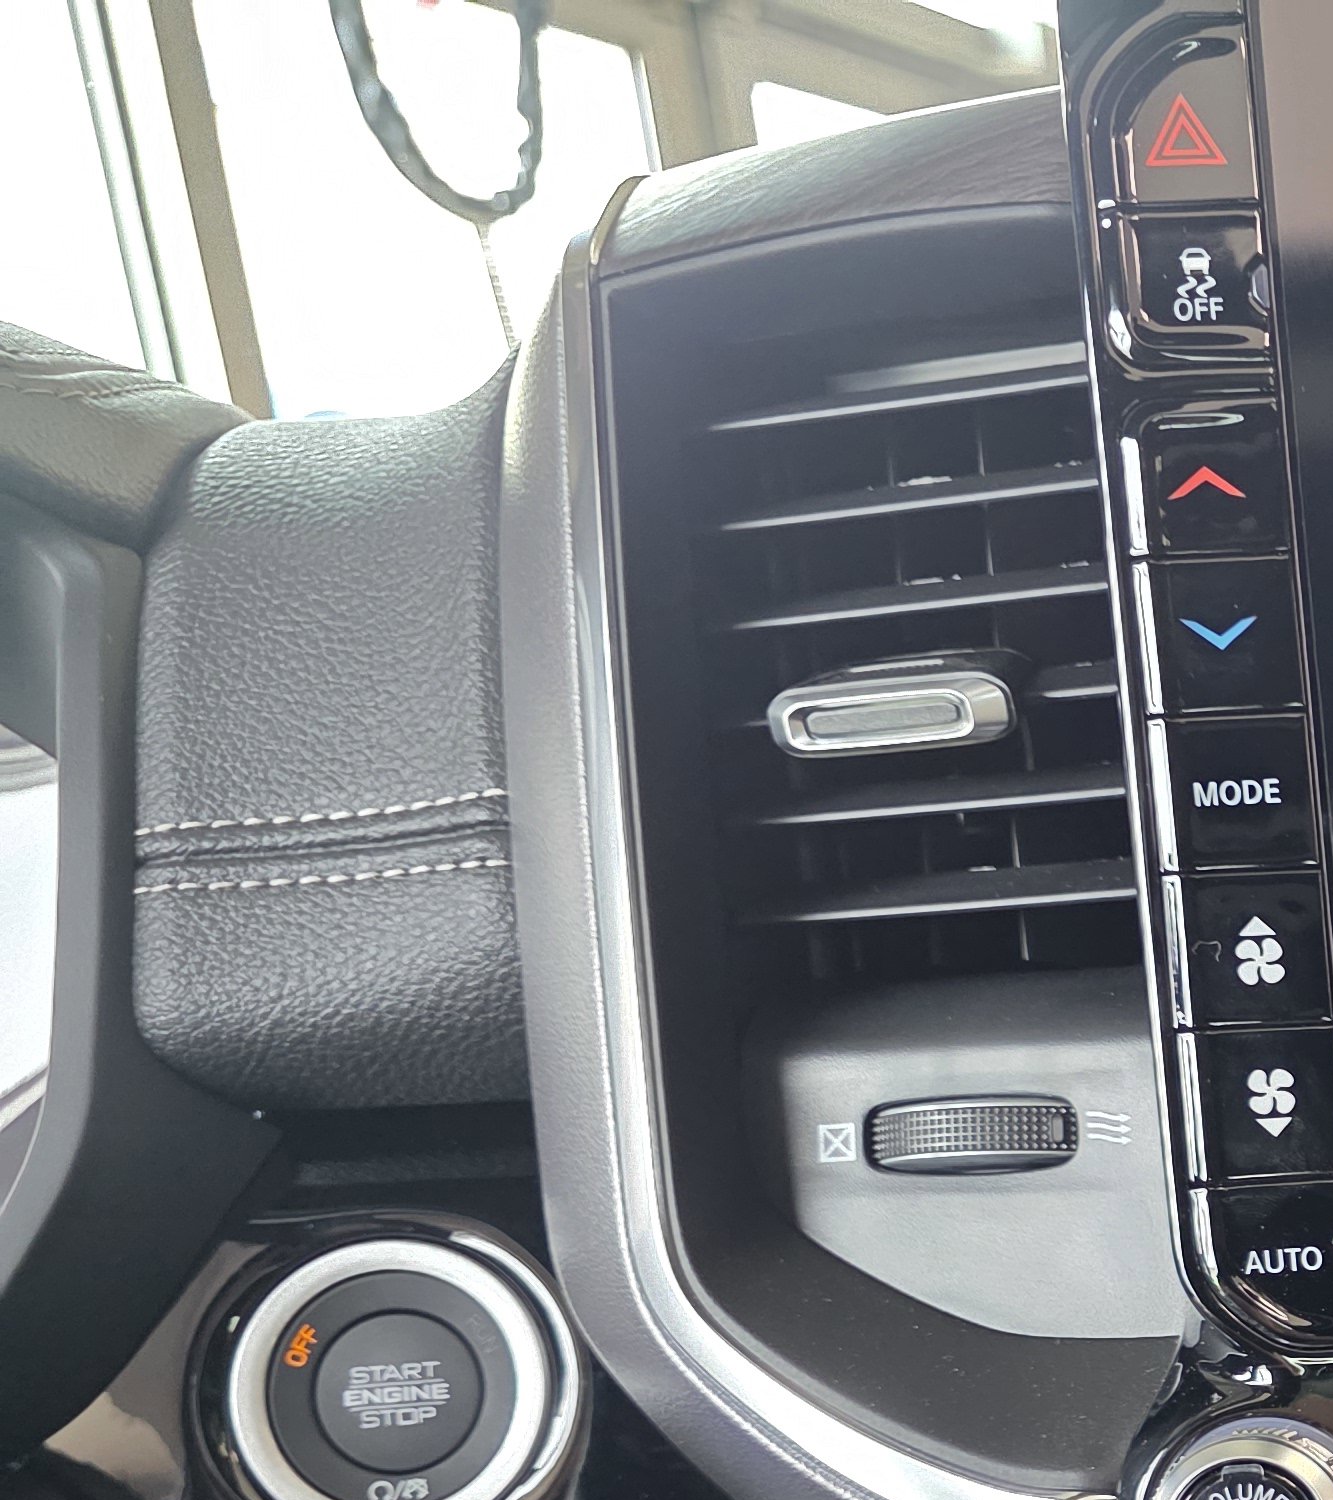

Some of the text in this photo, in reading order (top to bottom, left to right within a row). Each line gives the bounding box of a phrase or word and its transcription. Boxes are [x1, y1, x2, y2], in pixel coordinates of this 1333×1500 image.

[1173, 296, 1224, 322] OFF
[1193, 778, 1282, 807] MODE
[1245, 1246, 1324, 1275] AUTO
[284, 1323, 318, 1369] OFF
[348, 1361, 442, 1385] START
[342, 1383, 450, 1408] ENGINE
[358, 1406, 437, 1429] STOP
